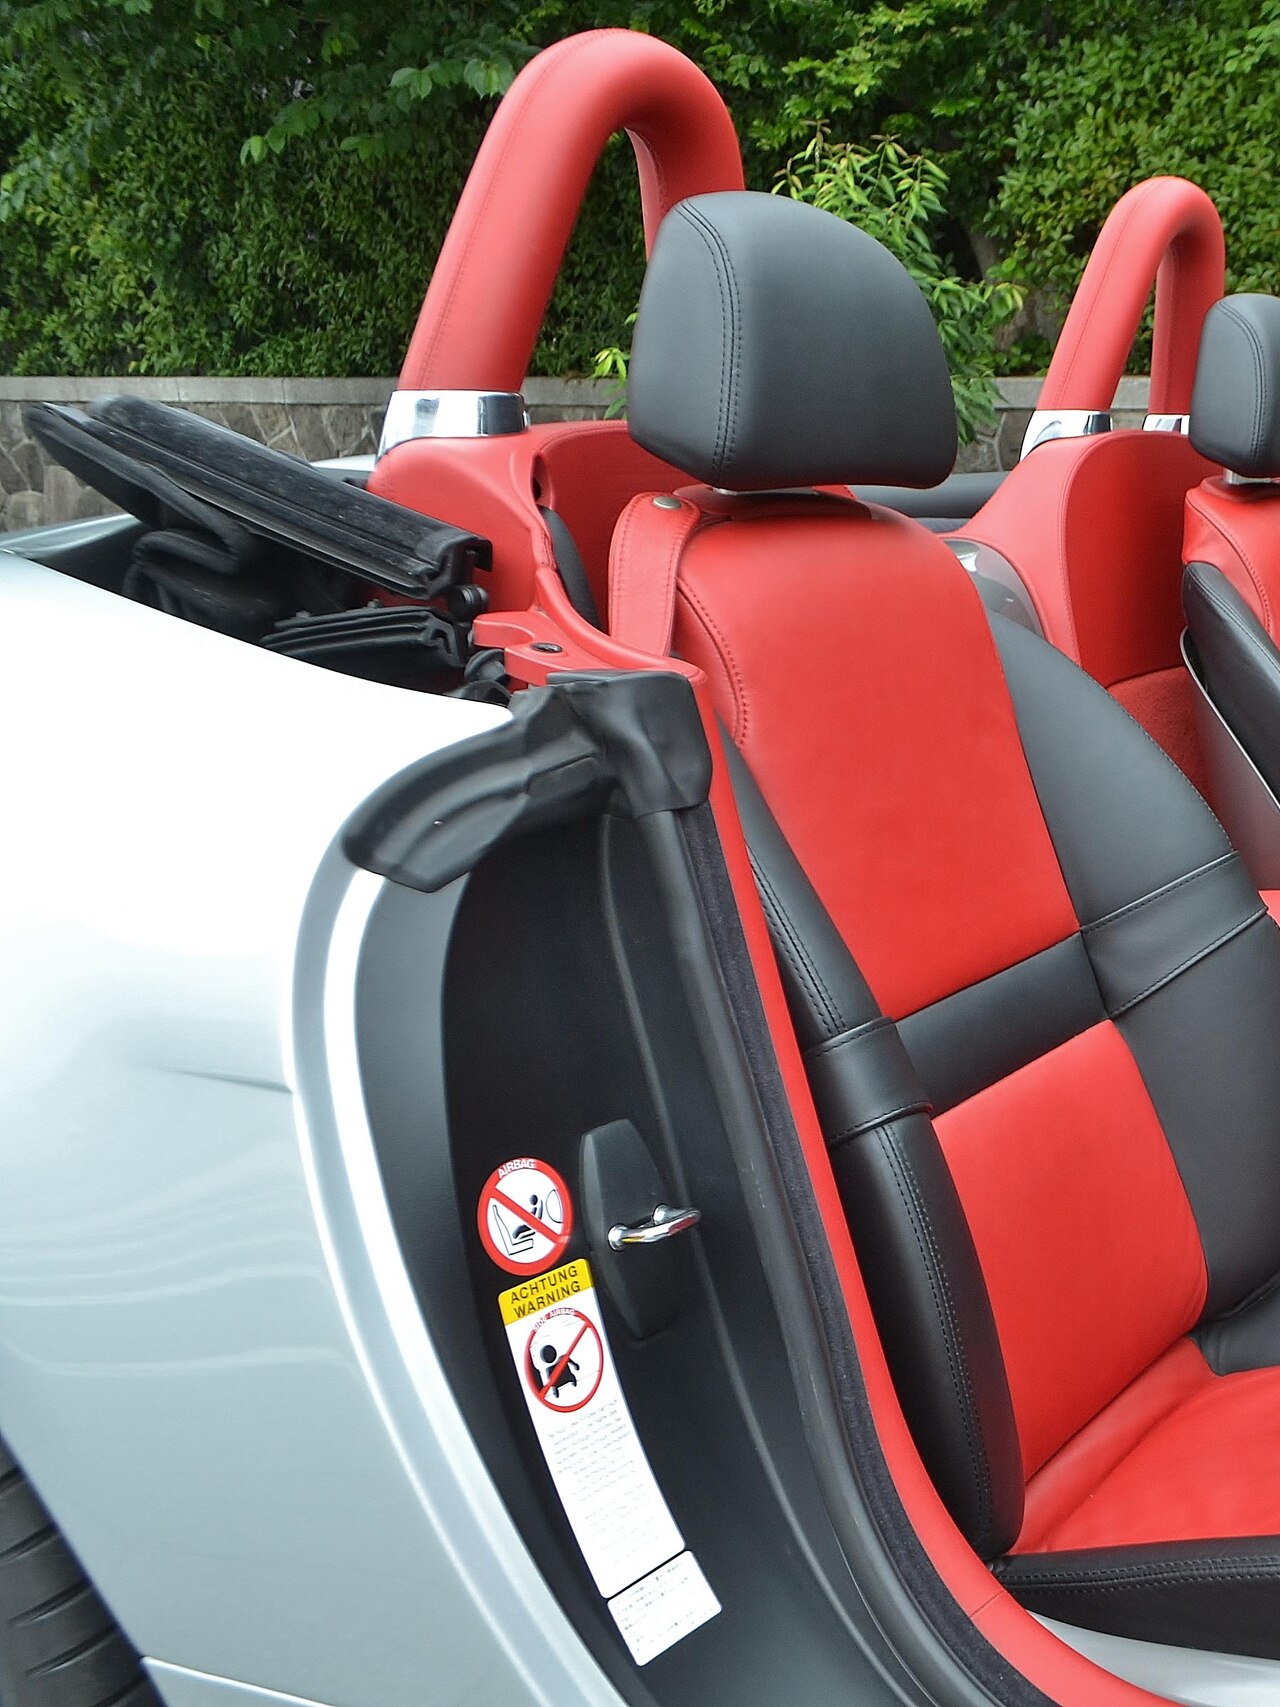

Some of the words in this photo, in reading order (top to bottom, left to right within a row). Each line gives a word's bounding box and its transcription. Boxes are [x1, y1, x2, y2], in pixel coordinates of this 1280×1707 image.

[498, 1158, 537, 1179] AIRBAG
[510, 1265, 578, 1304] ACHTUNG
[513, 1280, 581, 1319] WARNING
